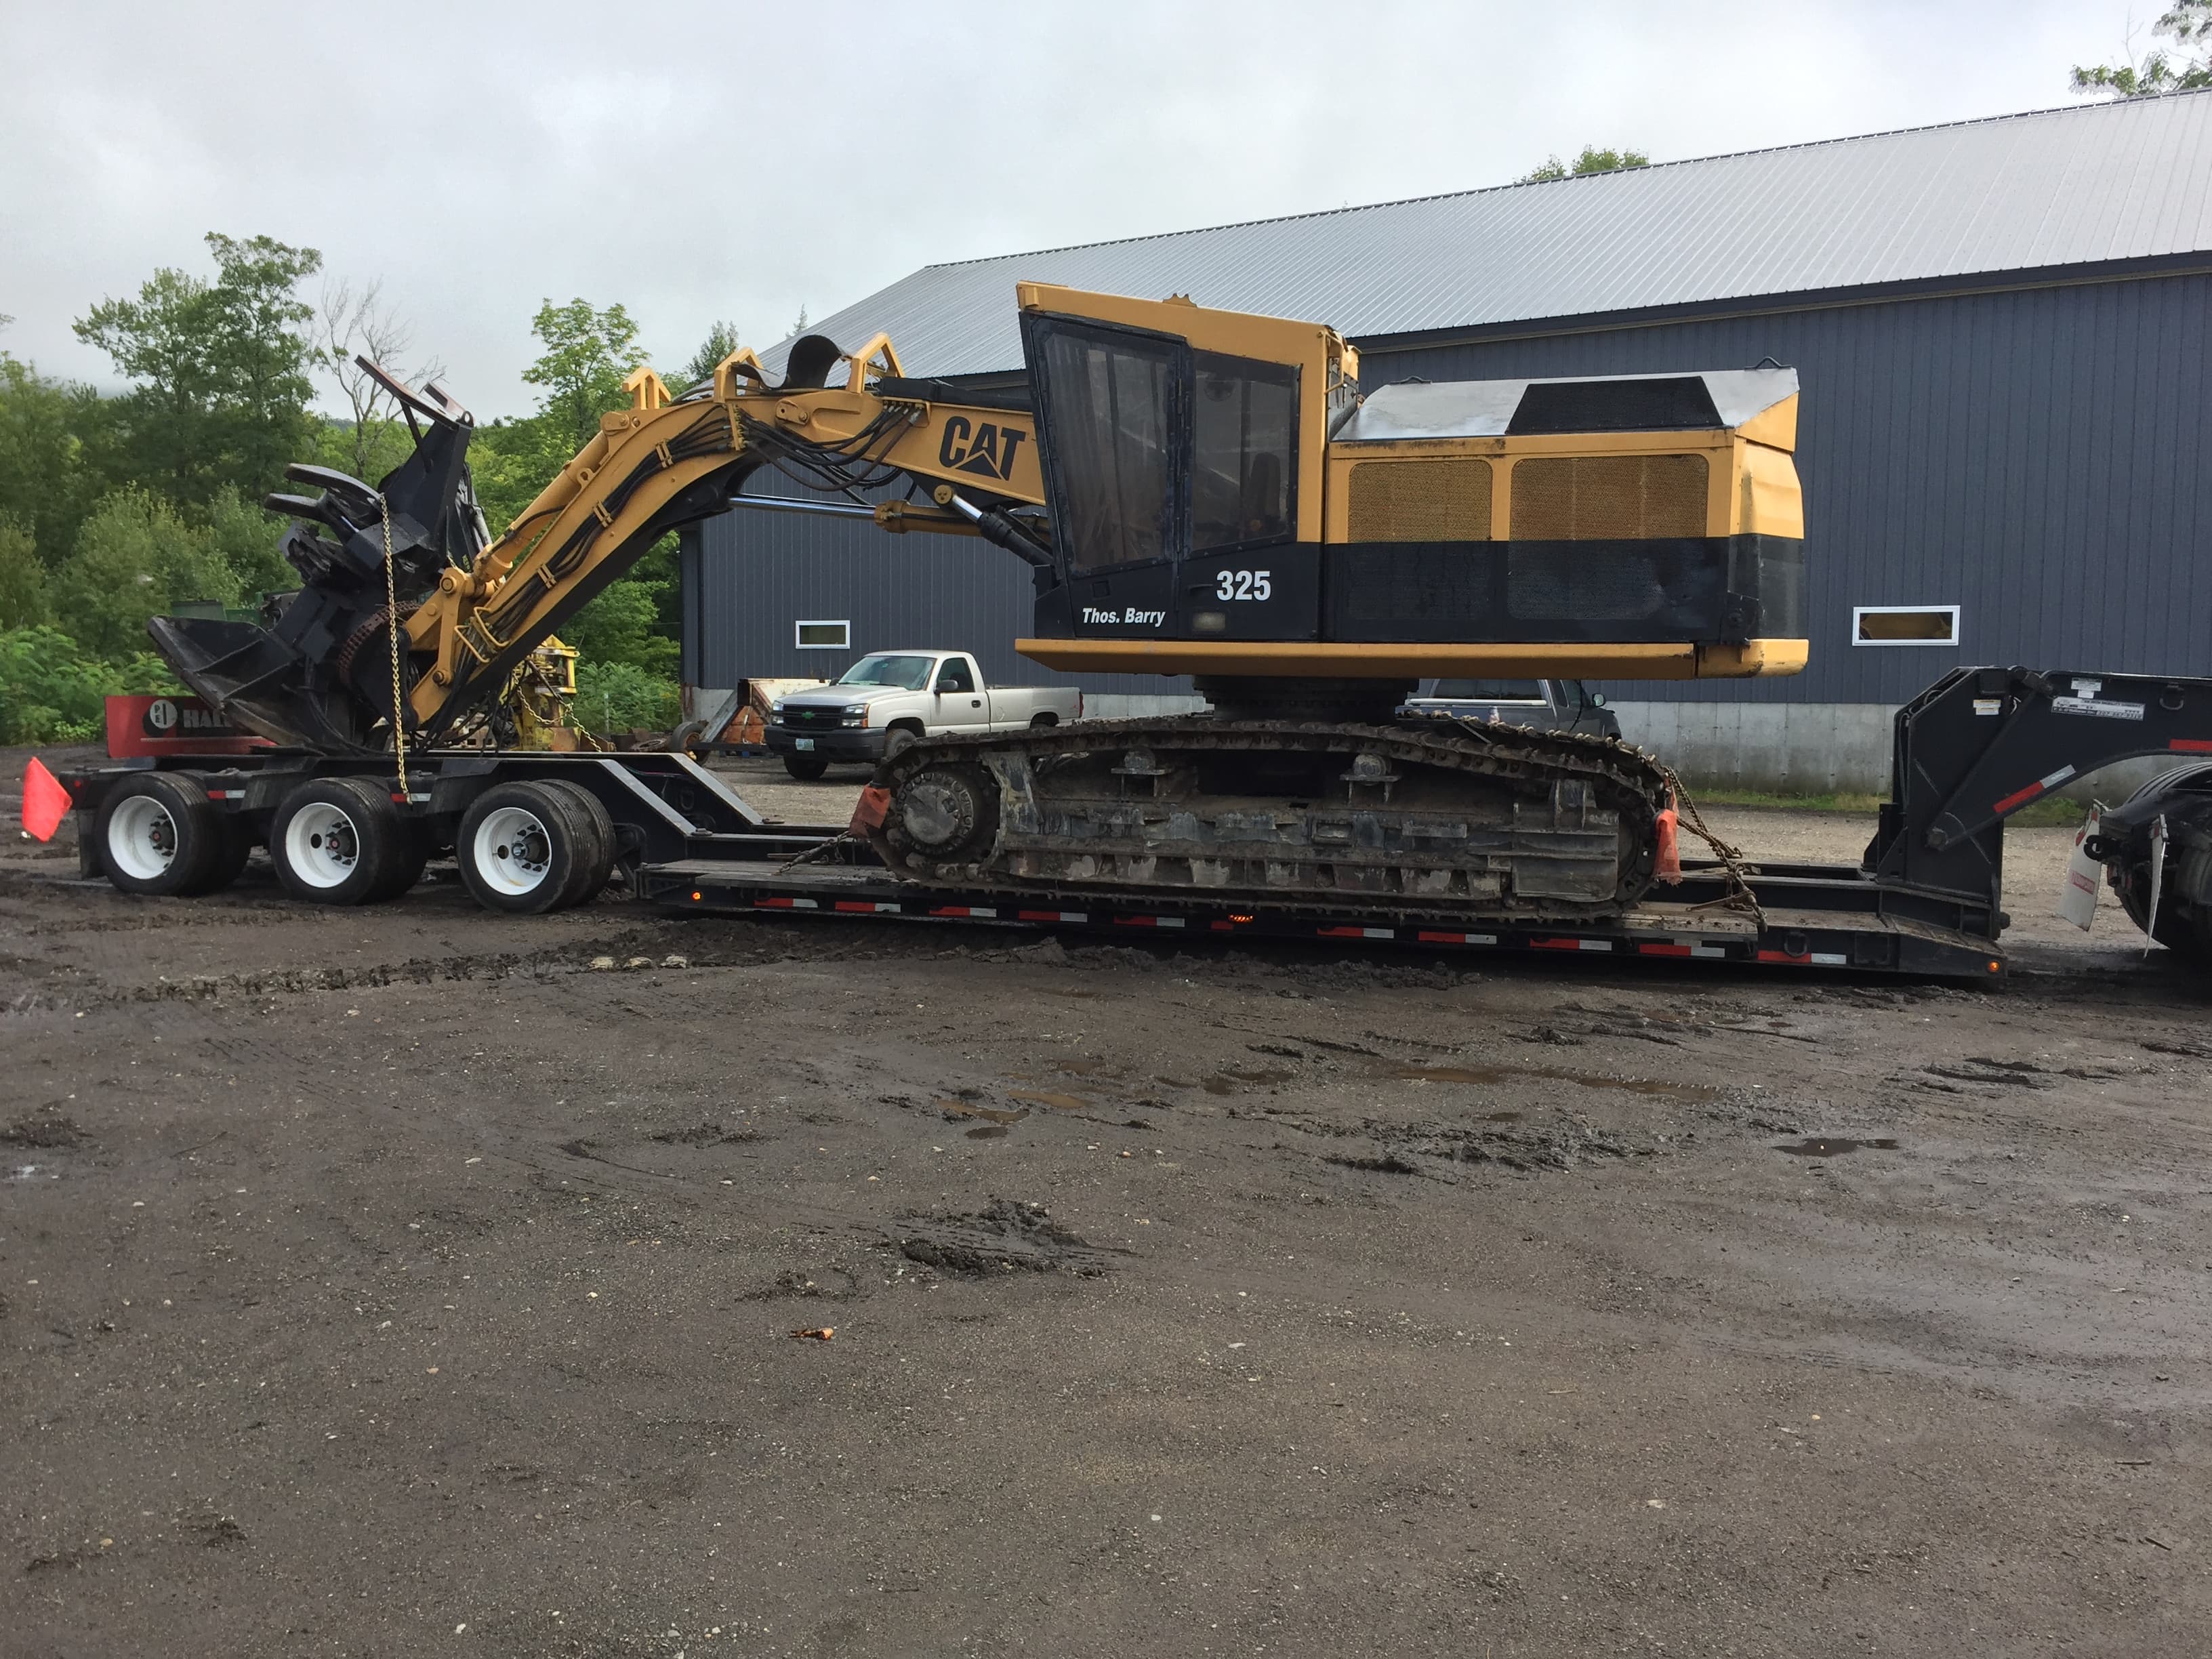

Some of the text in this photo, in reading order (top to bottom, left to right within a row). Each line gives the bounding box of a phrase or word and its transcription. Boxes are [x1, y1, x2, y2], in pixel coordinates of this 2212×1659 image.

[939, 415, 1026, 481] CAT
[1216, 570, 1271, 601] 325
[1083, 608, 1166, 627] Thos. Barry
